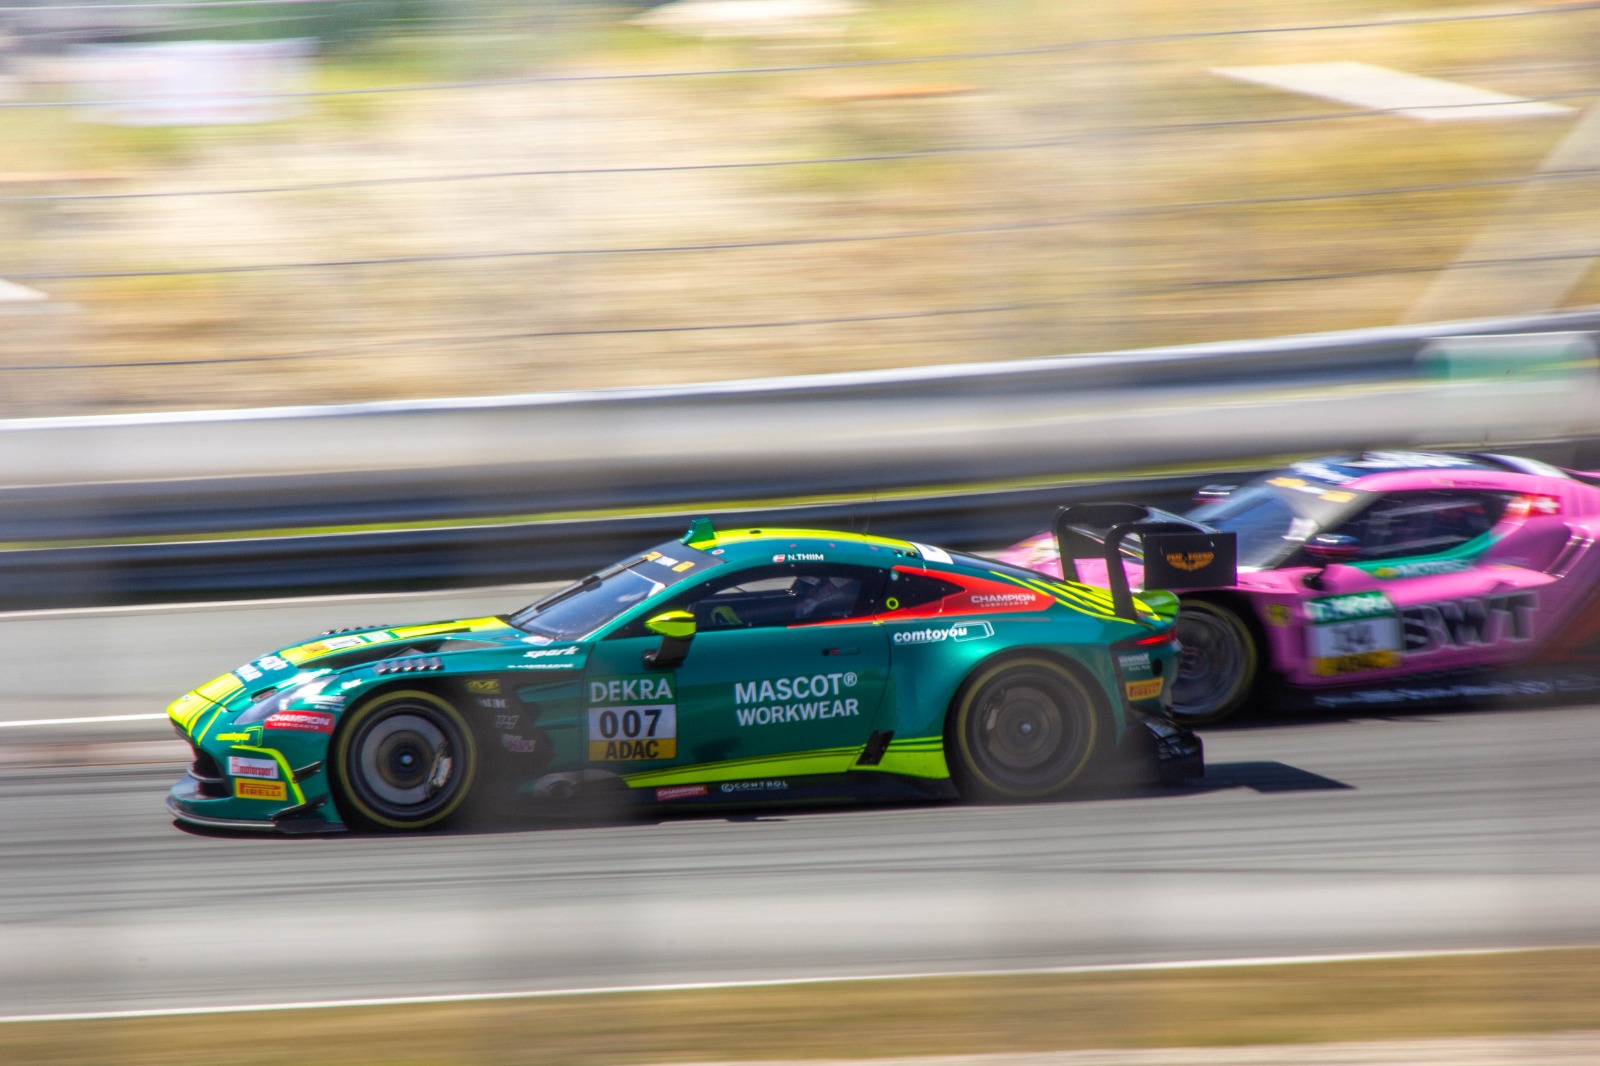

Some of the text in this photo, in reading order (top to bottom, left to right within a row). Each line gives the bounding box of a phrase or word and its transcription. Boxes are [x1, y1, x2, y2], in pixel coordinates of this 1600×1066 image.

[970, 593, 1036, 604] CHAMPION
[893, 627, 968, 642] comtoyou
[523, 646, 579, 658] spark
[591, 678, 673, 703] DEKRA
[736, 698, 860, 726] WORKWEAR
[268, 714, 331, 726] CHAMPION
[599, 708, 663, 739] 007
[605, 740, 660, 760] ADAC
[238, 765, 275, 778] motorsport
[238, 782, 282, 798] PIRELLI
